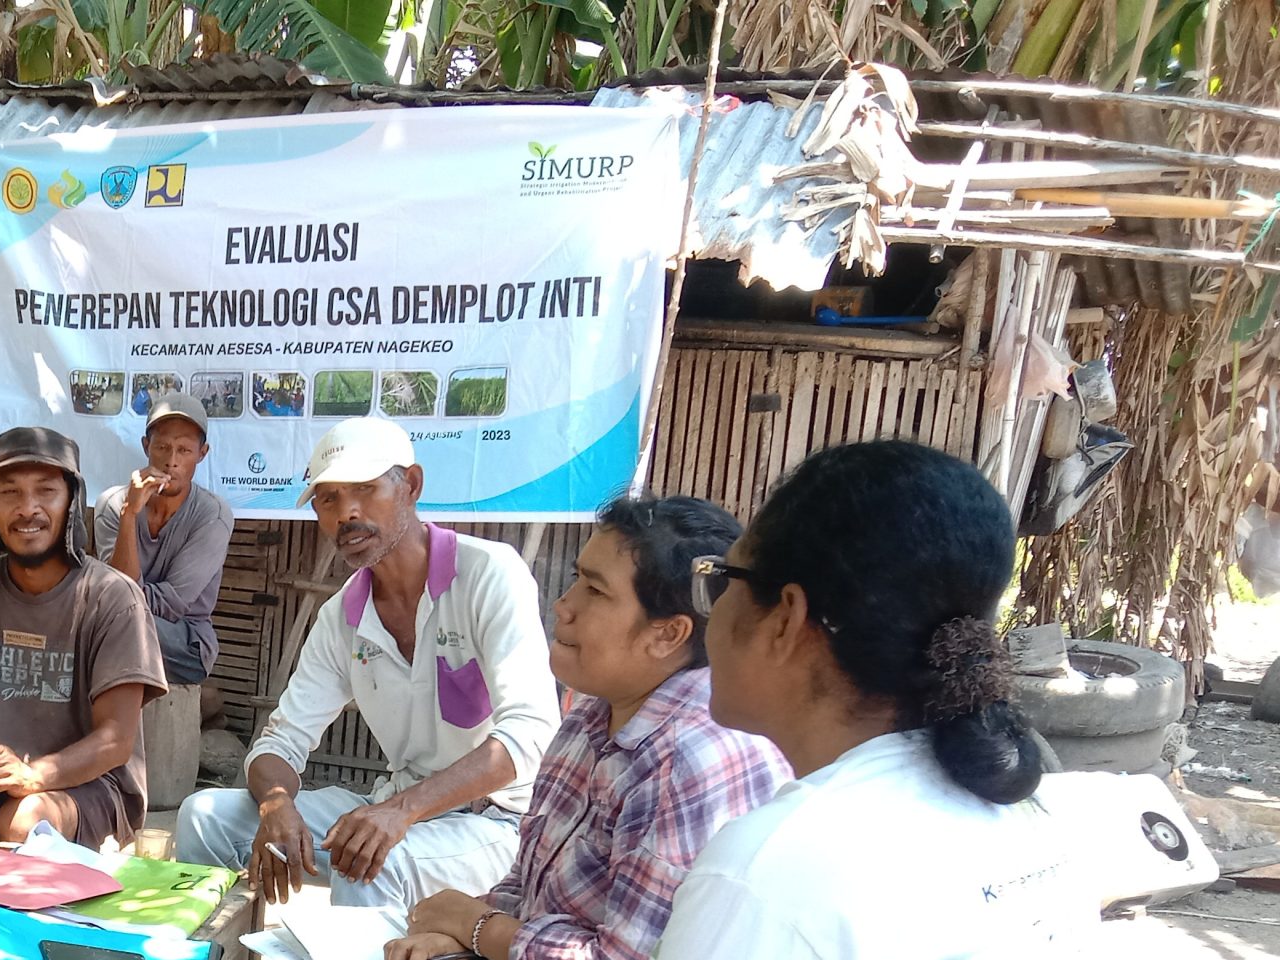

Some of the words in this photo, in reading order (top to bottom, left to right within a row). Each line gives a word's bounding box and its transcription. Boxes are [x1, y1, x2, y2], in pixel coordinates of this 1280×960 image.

[521, 155, 634, 181] SIMURP
[225, 222, 359, 265] EVALUASI
[14, 288, 161, 330] PENEREPAN
[169, 287, 318, 328] TEKNOLOGI
[327, 286, 382, 326] CSA
[391, 281, 536, 325] DEMPLOT
[538, 276, 601, 319] INTI
[130, 343, 214, 356] KECAMATAN
[216, 342, 272, 356] AESESA
[282, 341, 373, 355] KABUPATEN
[376, 340, 454, 354] NAGEKEO
[482, 430, 511, 441] 2023
[221, 476, 236, 485] THE
[237, 477, 268, 485] WORLD
[269, 477, 294, 486] BANK
